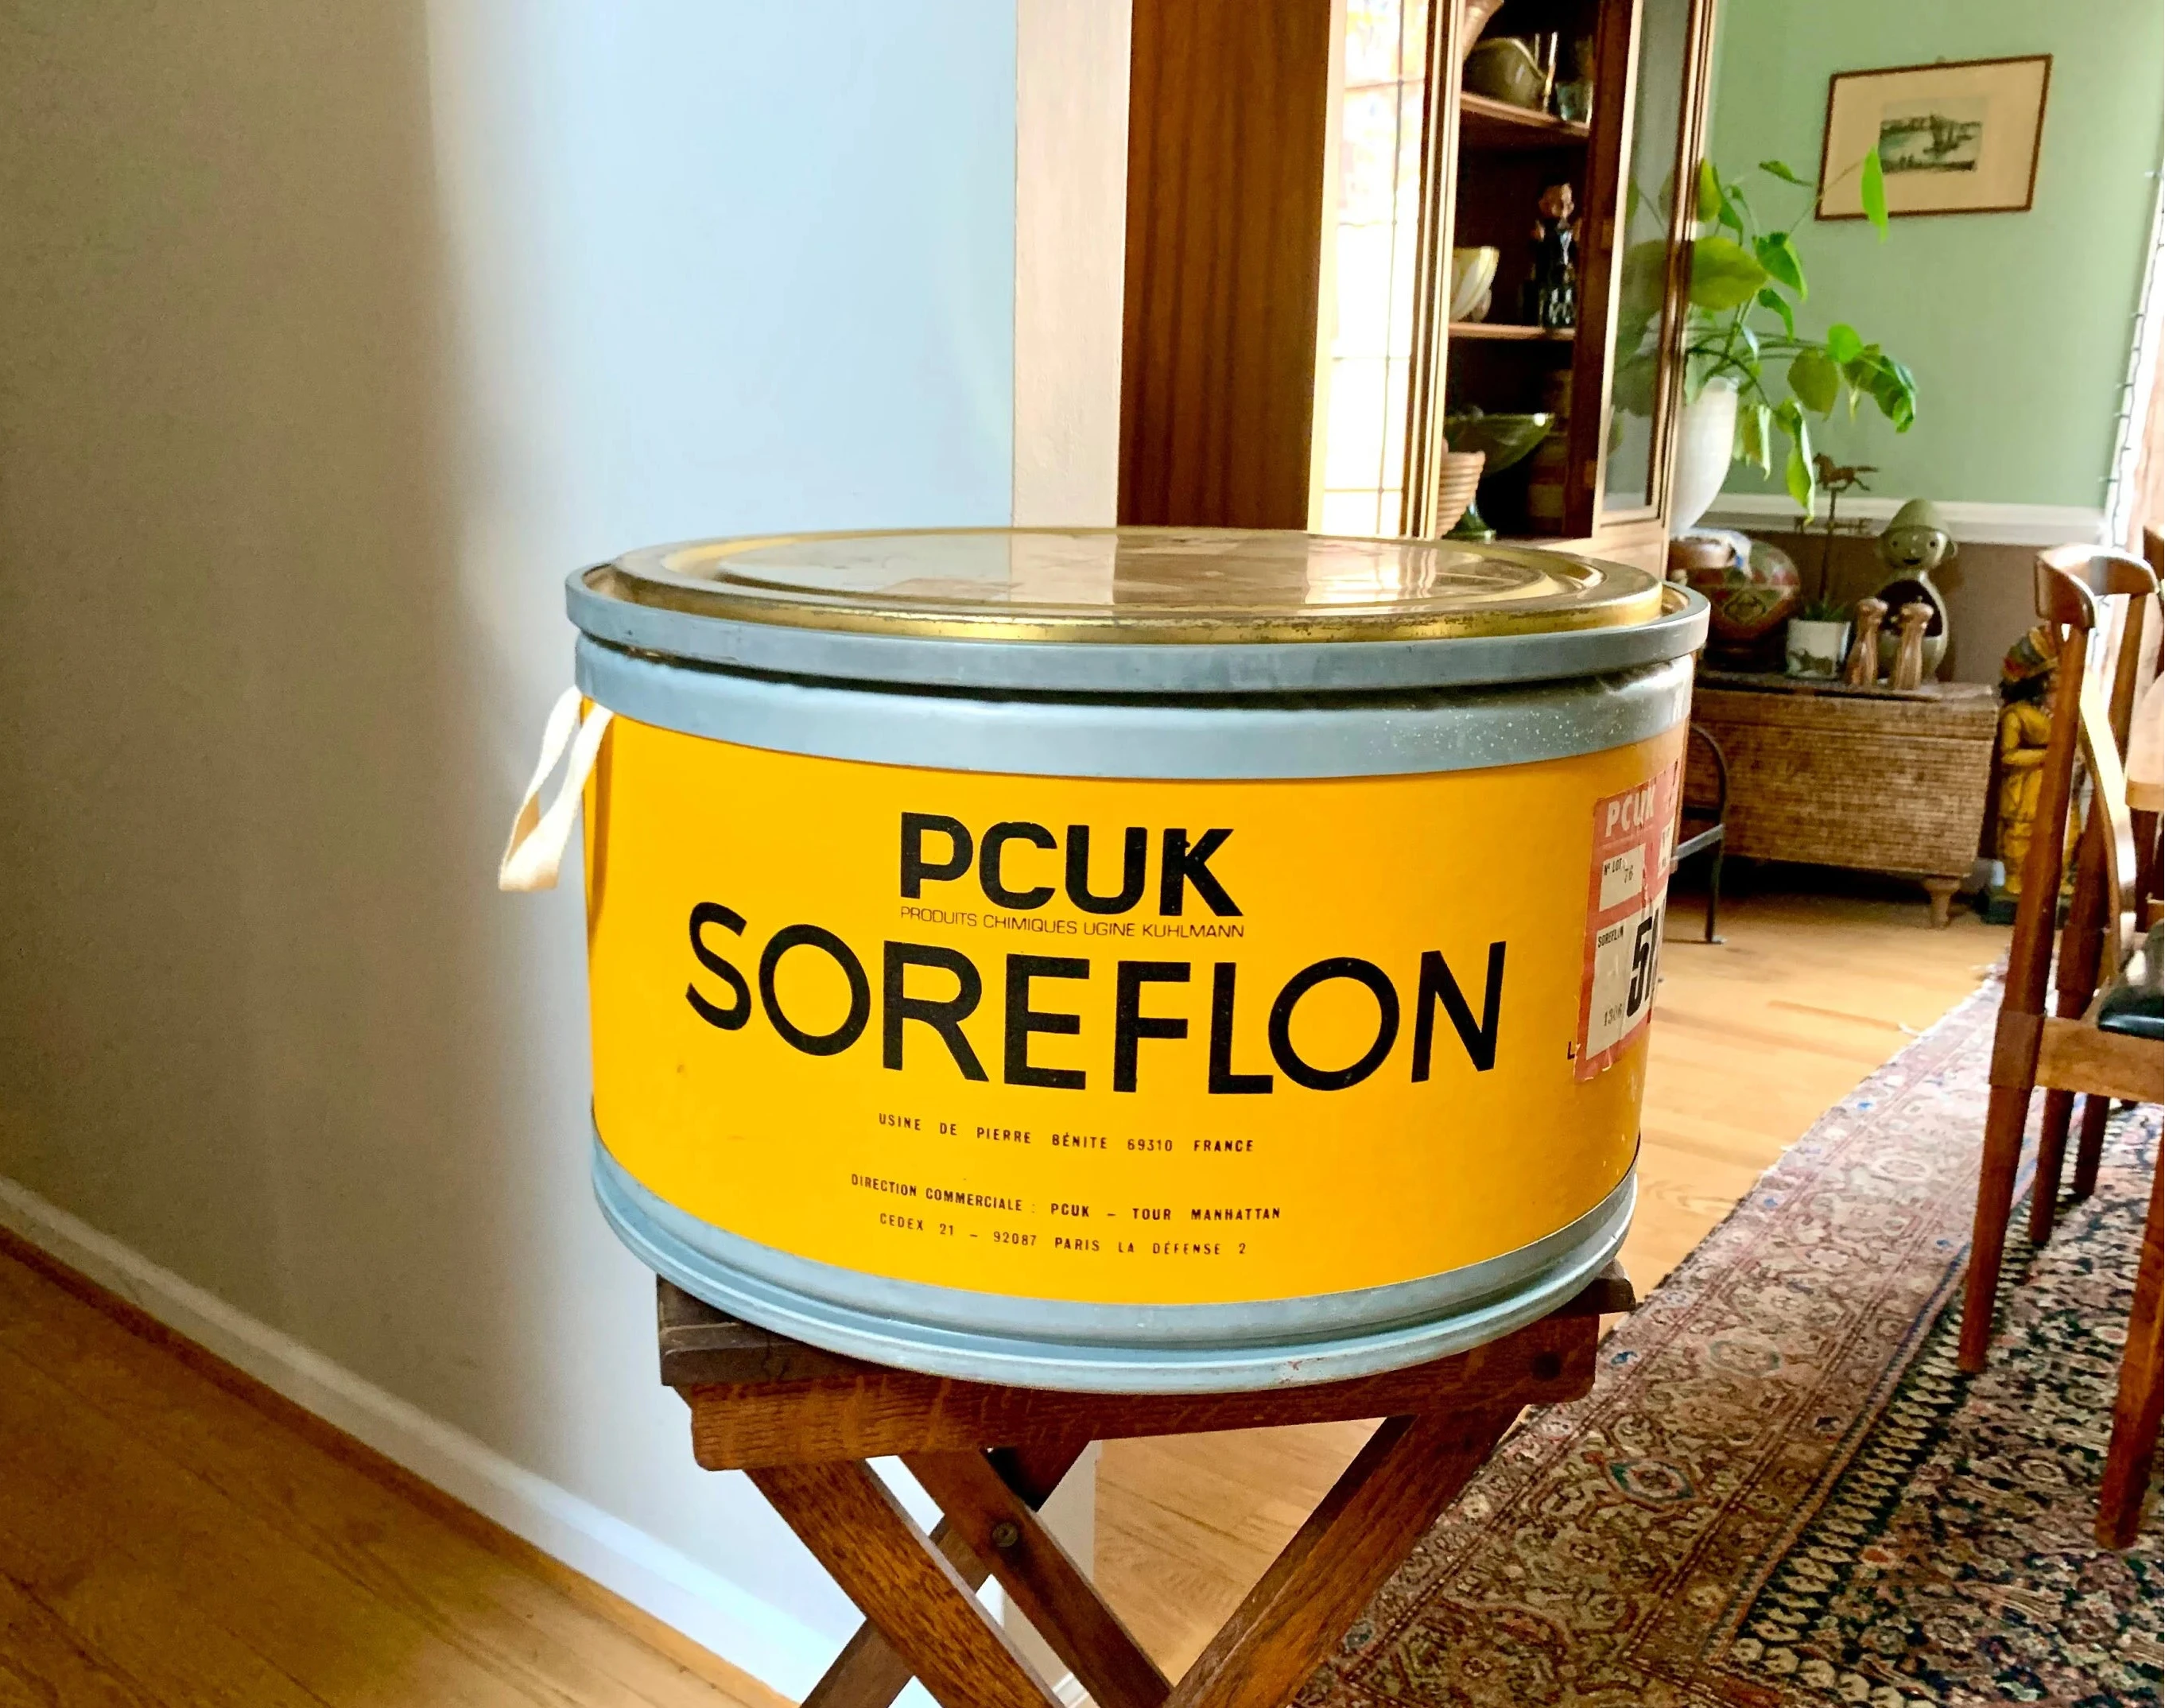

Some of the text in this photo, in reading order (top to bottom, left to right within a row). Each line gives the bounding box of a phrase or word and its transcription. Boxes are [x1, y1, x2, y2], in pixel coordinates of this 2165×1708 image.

[1605, 785, 1655, 837] PCUK
[900, 811, 1244, 917] PCUK
[1612, 857, 1623, 873] LOT
[900, 906, 1245, 939] PRODUITS CHIMIQUES UGINE KUHLMANN
[685, 900, 1507, 1096] SOREFLON
[879, 1112, 1254, 1152] USINE DE PIERRE BÉNITE 69310 FRANCE
[851, 1173, 918, 1198] DIRECTION
[925, 1186, 1023, 1212] COMMERCIALE
[1050, 1202, 1091, 1218] PCUK
[1131, 1207, 1172, 1221] TOUR
[1190, 1206, 1281, 1221] MANHATTAN
[879, 1213, 925, 1232] CEDEX
[939, 1223, 955, 1236] 21
[992, 1230, 1038, 1247] 92087
[1054, 1236, 1100, 1252] PARIS
[1118, 1241, 1135, 1254] LA
[1152, 1240, 1221, 1255] DÉFENSE
[1238, 1242, 1247, 1255] 2
